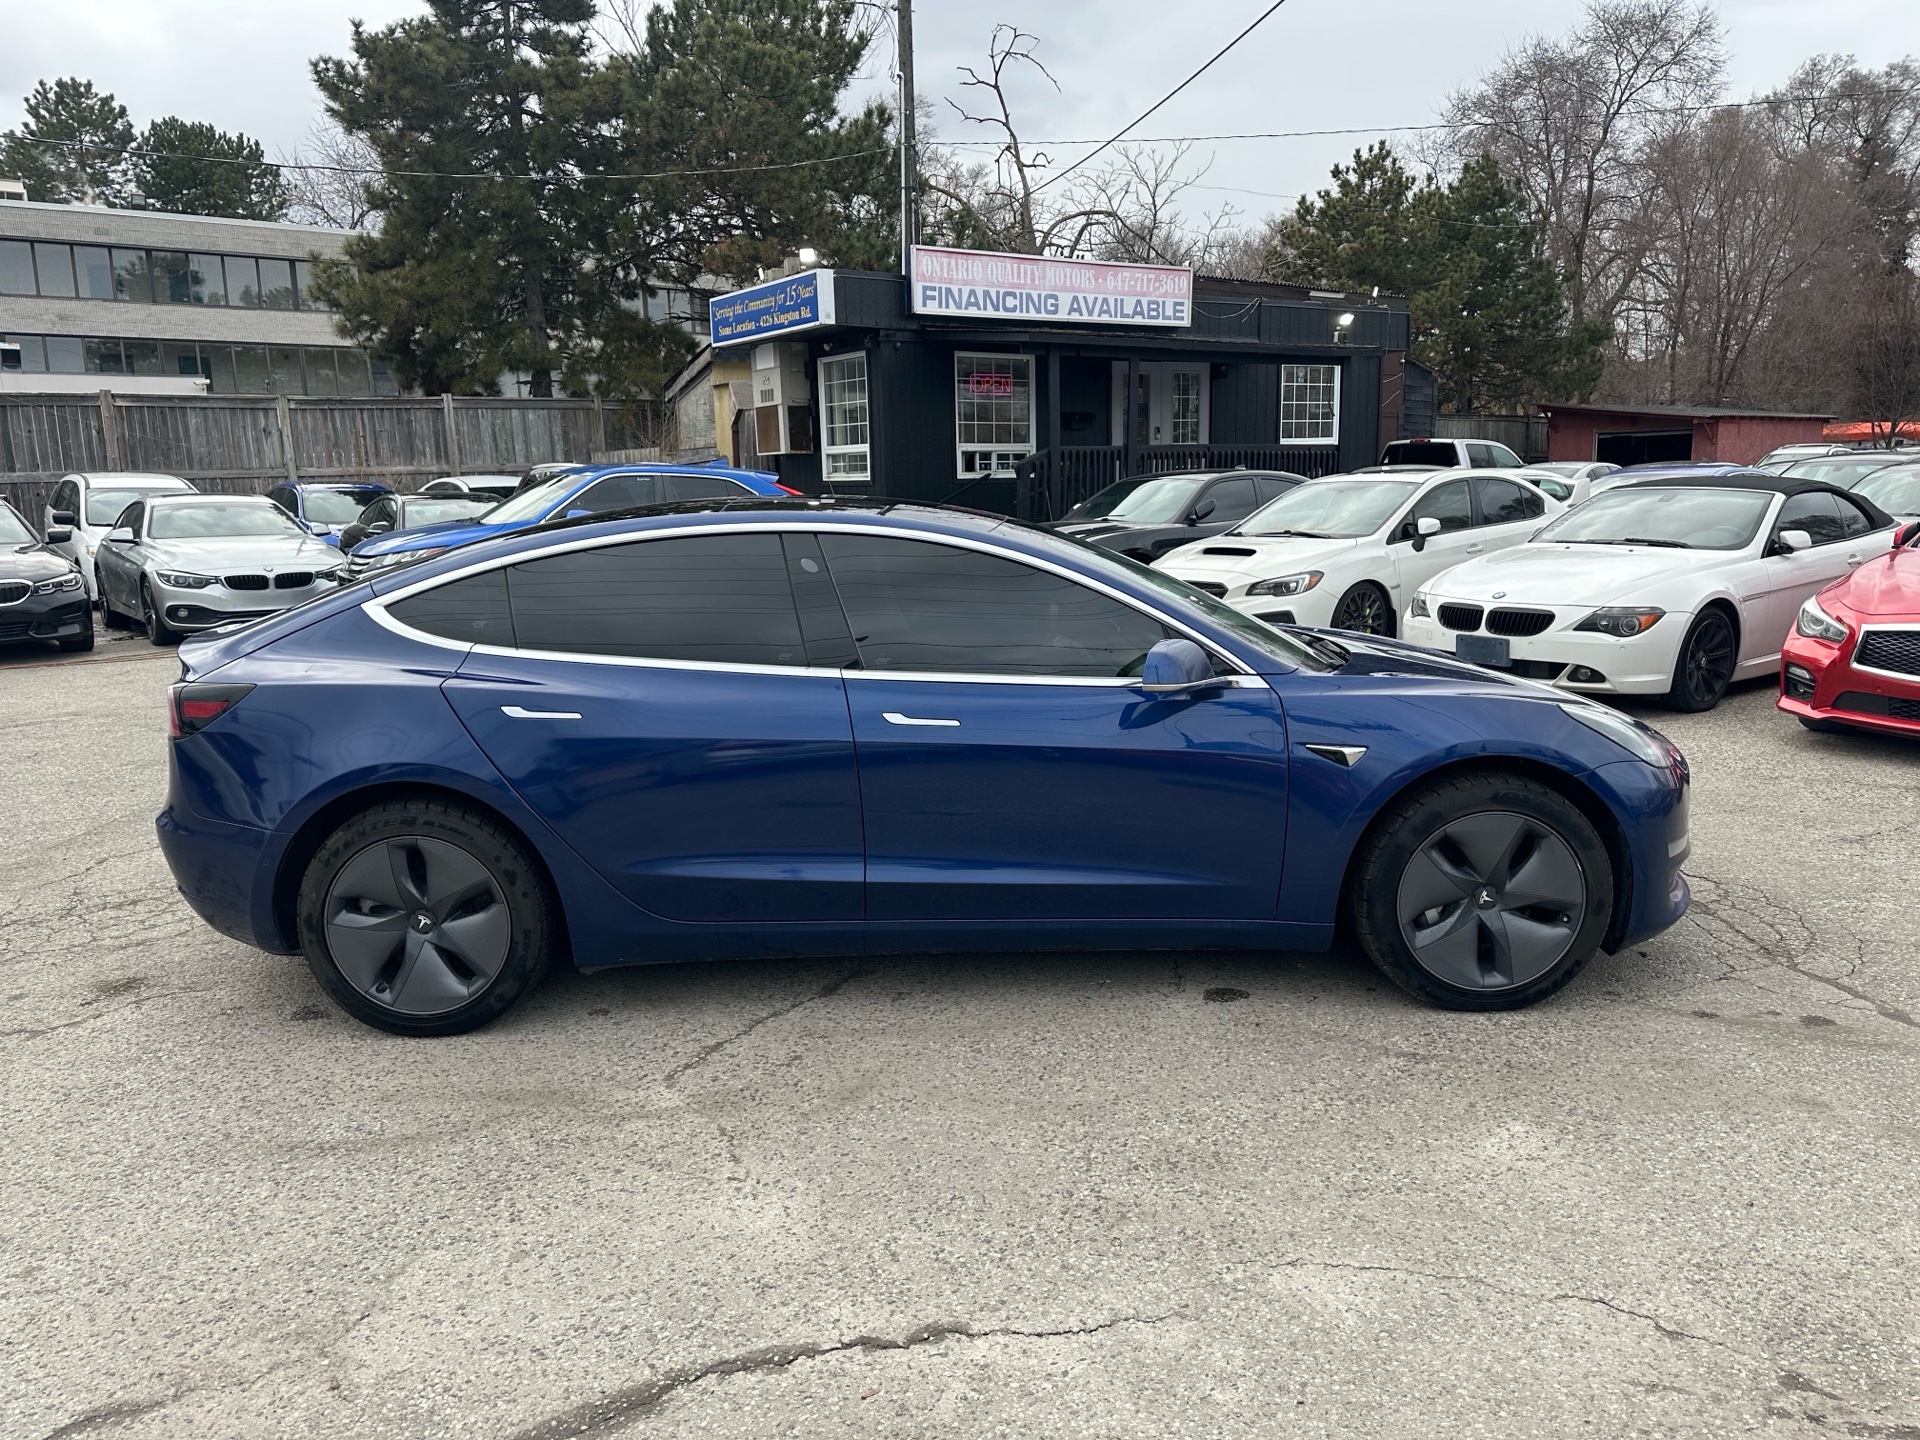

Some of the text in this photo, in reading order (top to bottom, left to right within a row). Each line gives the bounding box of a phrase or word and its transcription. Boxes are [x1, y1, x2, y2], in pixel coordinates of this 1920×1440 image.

[921, 255, 1187, 294] ONTARIO QUALITY MOTORS 647-717-3619
[735, 300, 743, 315] the
[744, 294, 775, 311] Community
[775, 290, 785, 311] for
[785, 283, 797, 306] 15
[922, 285, 1185, 321] FINANCING AVAILABLE
[718, 324, 732, 337] Same
[732, 319, 756, 334] Location
[759, 314, 773, 328] 4226
[773, 310, 800, 325] Kingston
[800, 306, 812, 319] Rd.
[971, 377, 1011, 392] OPEN
